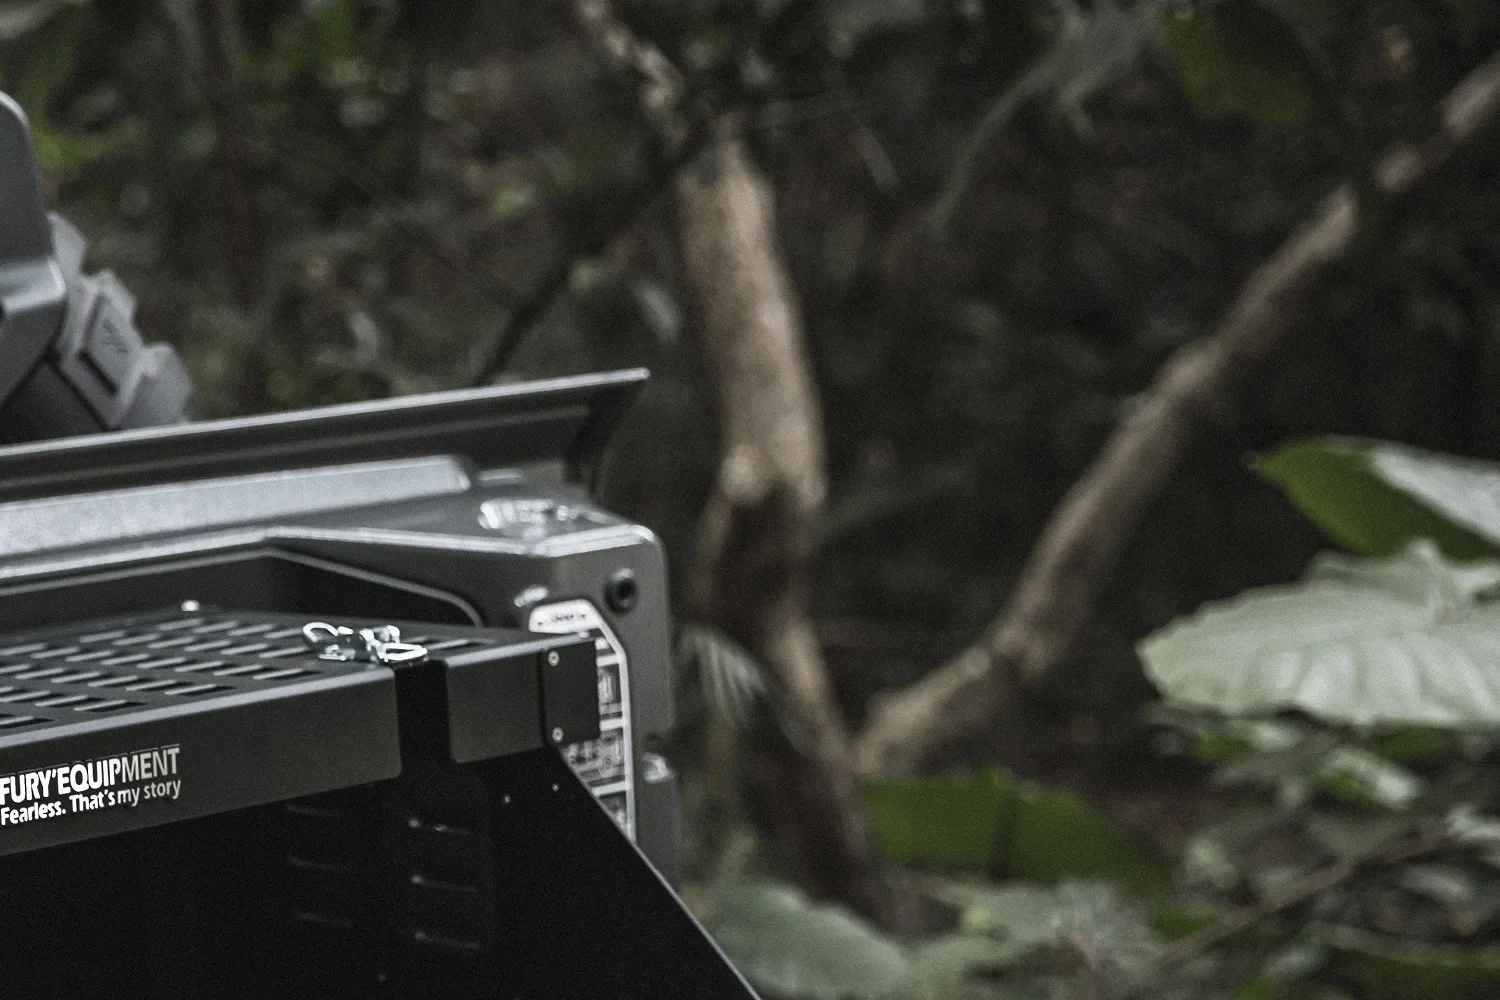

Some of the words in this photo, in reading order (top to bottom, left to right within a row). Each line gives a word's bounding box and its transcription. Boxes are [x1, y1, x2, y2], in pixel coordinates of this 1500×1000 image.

[0, 801, 67, 826] Fearless.
[69, 788, 116, 814] That's
[117, 784, 140, 807] my
[143, 778, 182, 800] story
